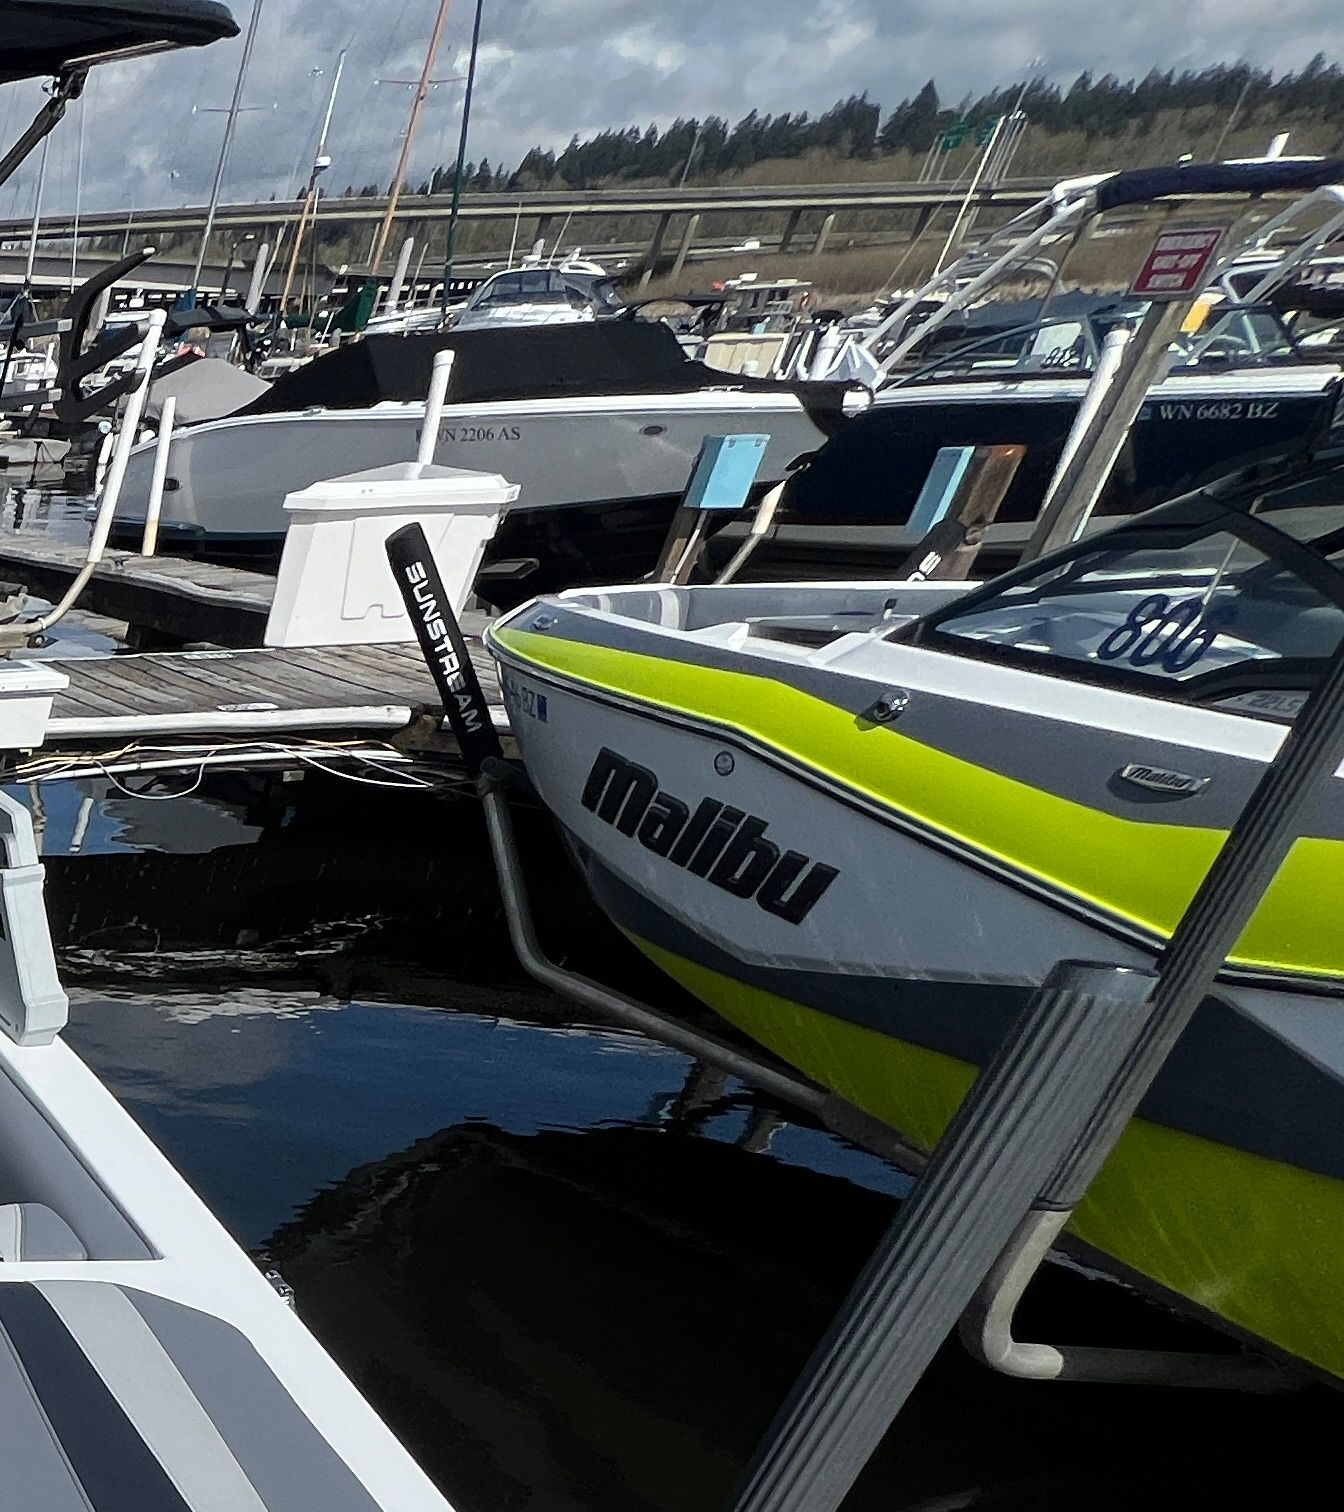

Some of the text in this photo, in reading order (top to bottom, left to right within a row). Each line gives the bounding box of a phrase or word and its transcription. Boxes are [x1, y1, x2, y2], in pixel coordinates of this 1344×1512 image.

[1159, 402, 1279, 420] WN 6682 BZ
[459, 427, 495, 443] 2206
[497, 426, 521, 441] AS
[405, 561, 483, 734] SUNSTREAM
[1128, 767, 1193, 789] Malibu
[580, 746, 842, 926] Malibu
